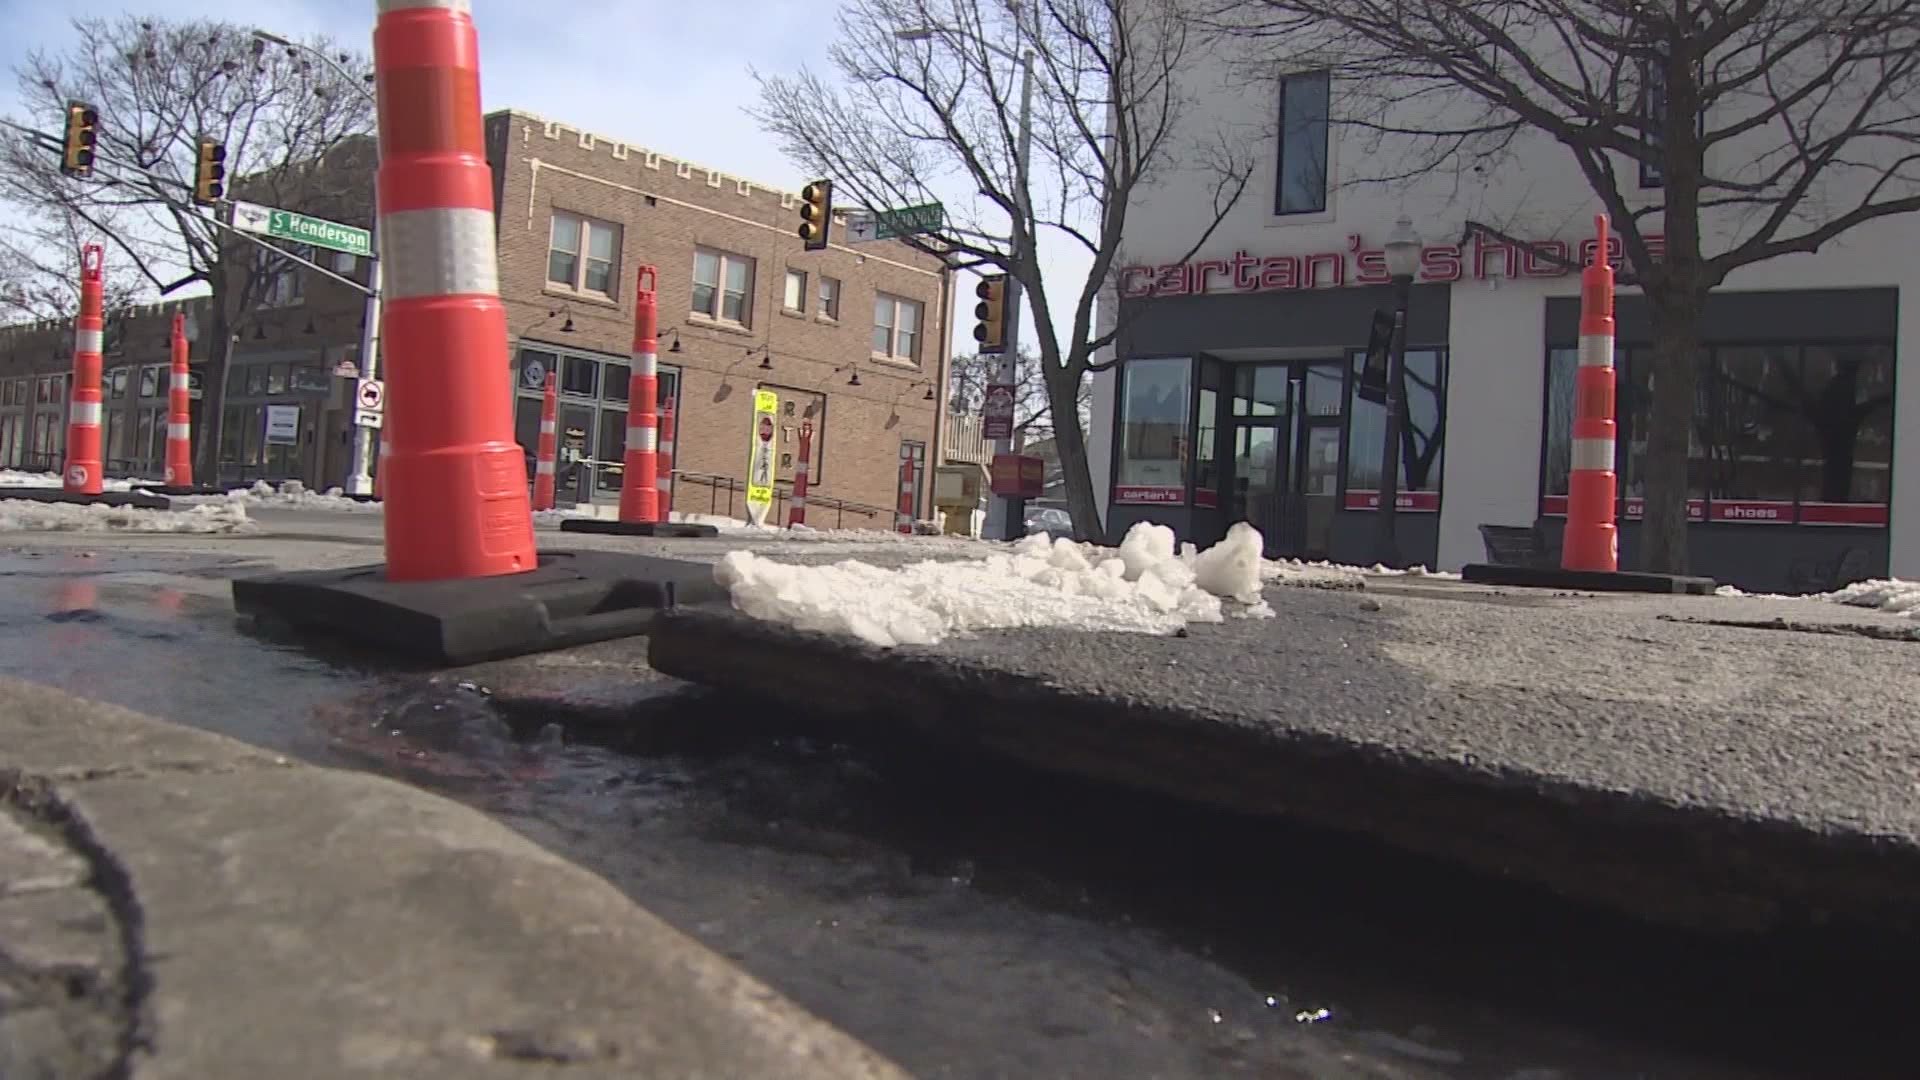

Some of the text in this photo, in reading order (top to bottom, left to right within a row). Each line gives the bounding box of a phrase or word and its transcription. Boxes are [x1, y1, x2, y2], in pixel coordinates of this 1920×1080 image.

[274, 213, 284, 228] S
[290, 214, 366, 246] Henderson
[1123, 234, 1391, 296] cartan's
[1724, 506, 1778, 518] shoes
